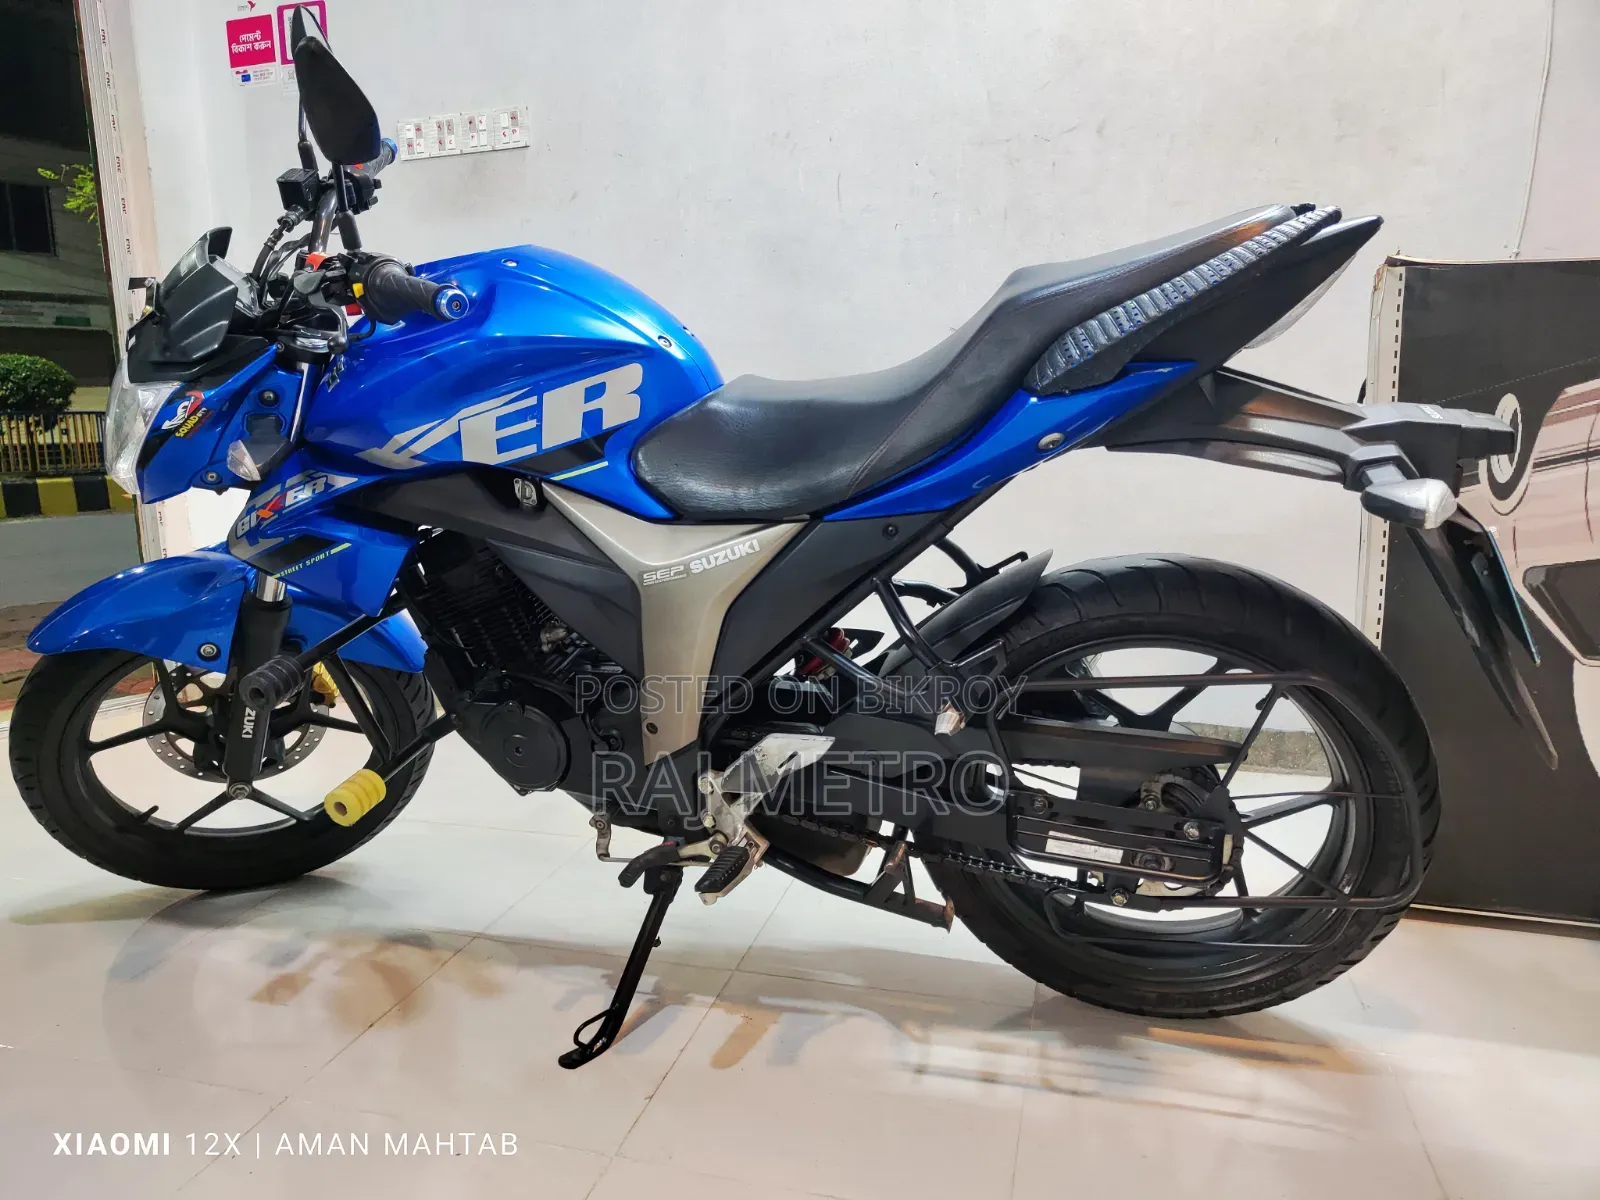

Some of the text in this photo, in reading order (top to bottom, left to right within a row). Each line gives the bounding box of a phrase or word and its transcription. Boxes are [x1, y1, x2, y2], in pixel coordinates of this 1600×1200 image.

[280, 550, 330, 577] STREET SPORT
[689, 538, 761, 574] SUZUKI
[241, 706, 257, 739] ZUKI
